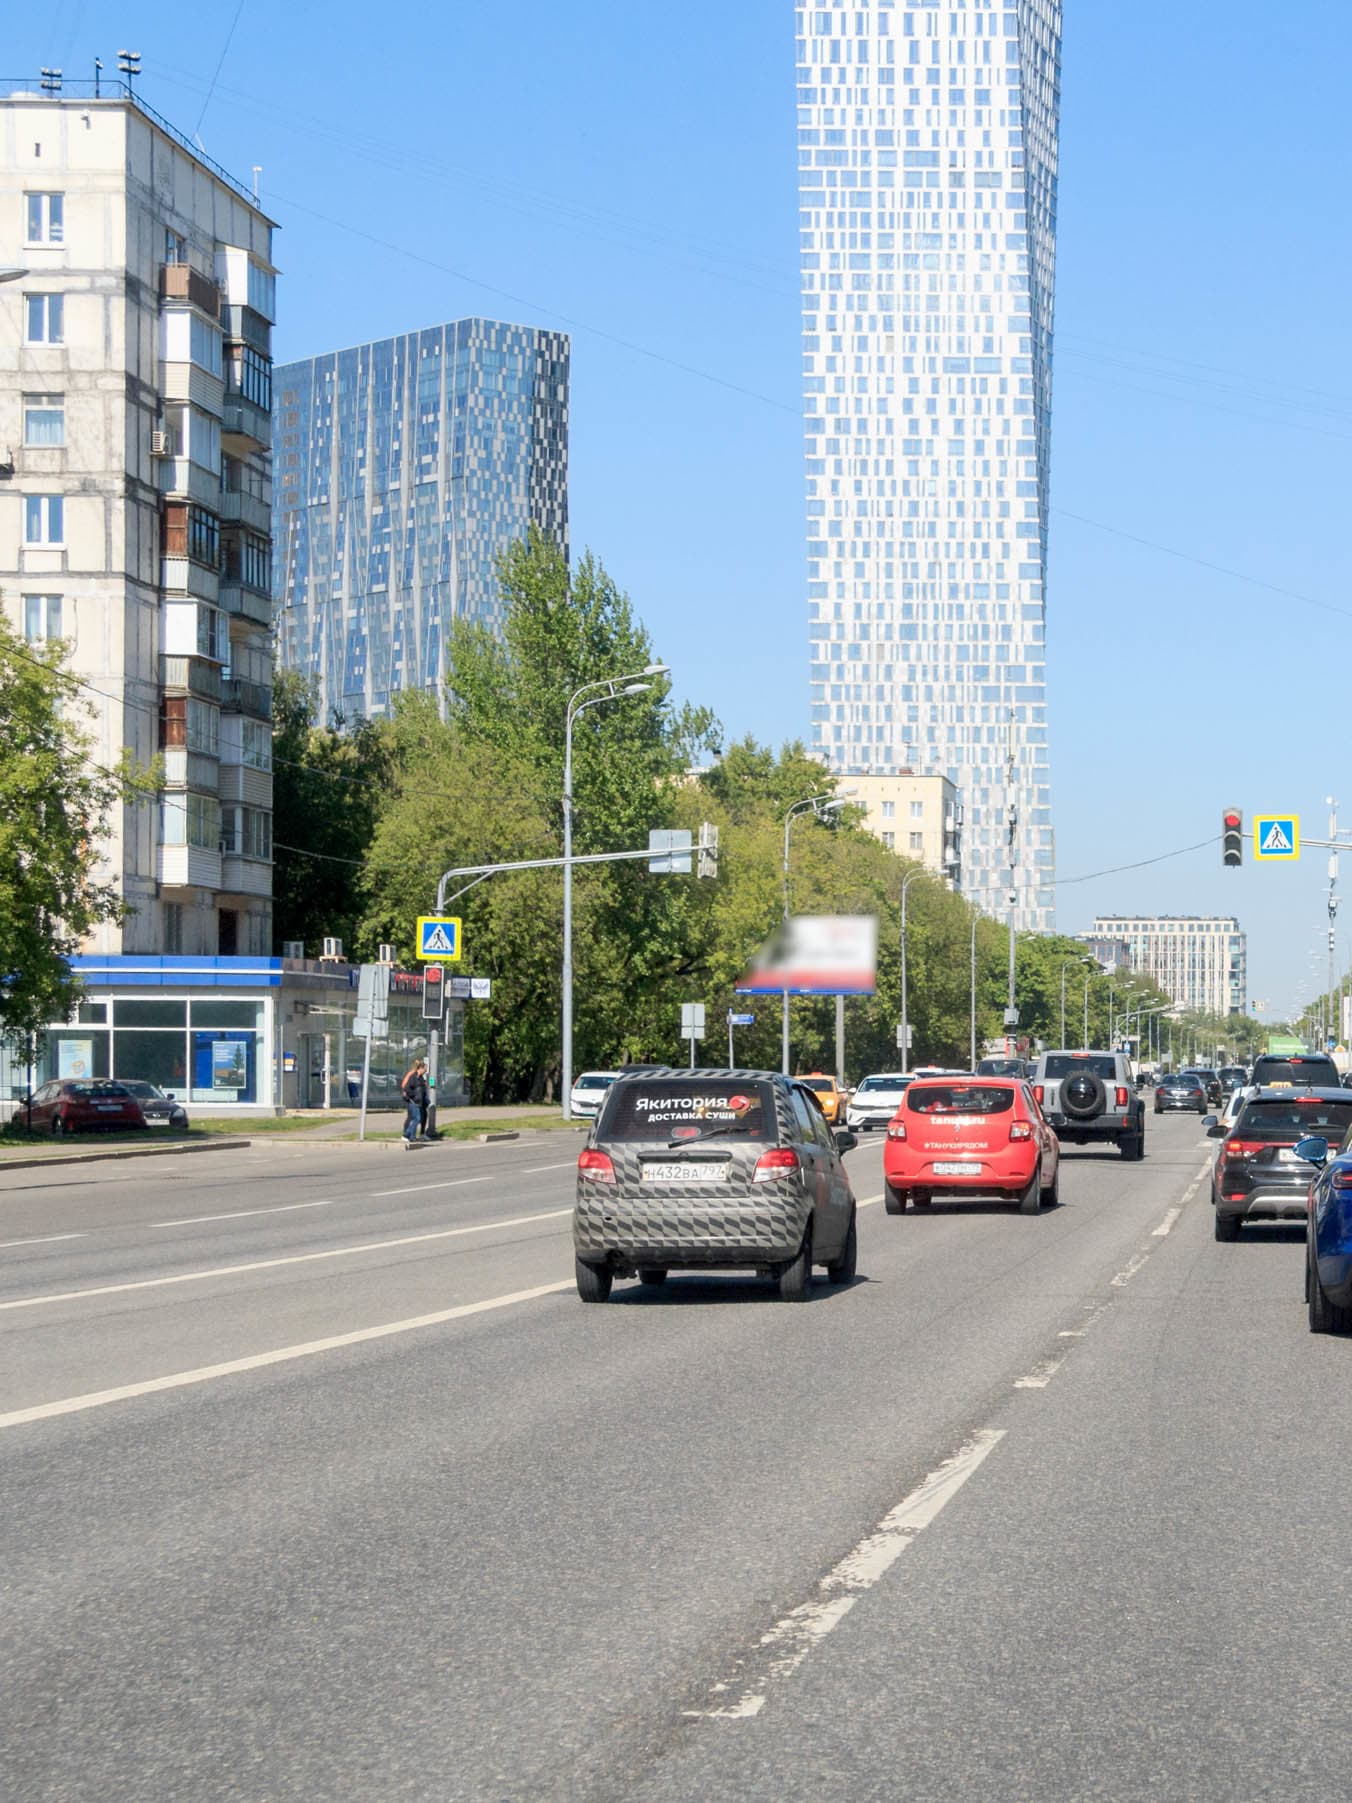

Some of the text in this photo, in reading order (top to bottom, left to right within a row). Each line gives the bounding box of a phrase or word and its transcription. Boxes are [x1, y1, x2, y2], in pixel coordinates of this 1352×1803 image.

[635, 1097, 729, 1111] Якитория
[648, 1111, 736, 1122] ДОСТАВКА СУШИ
